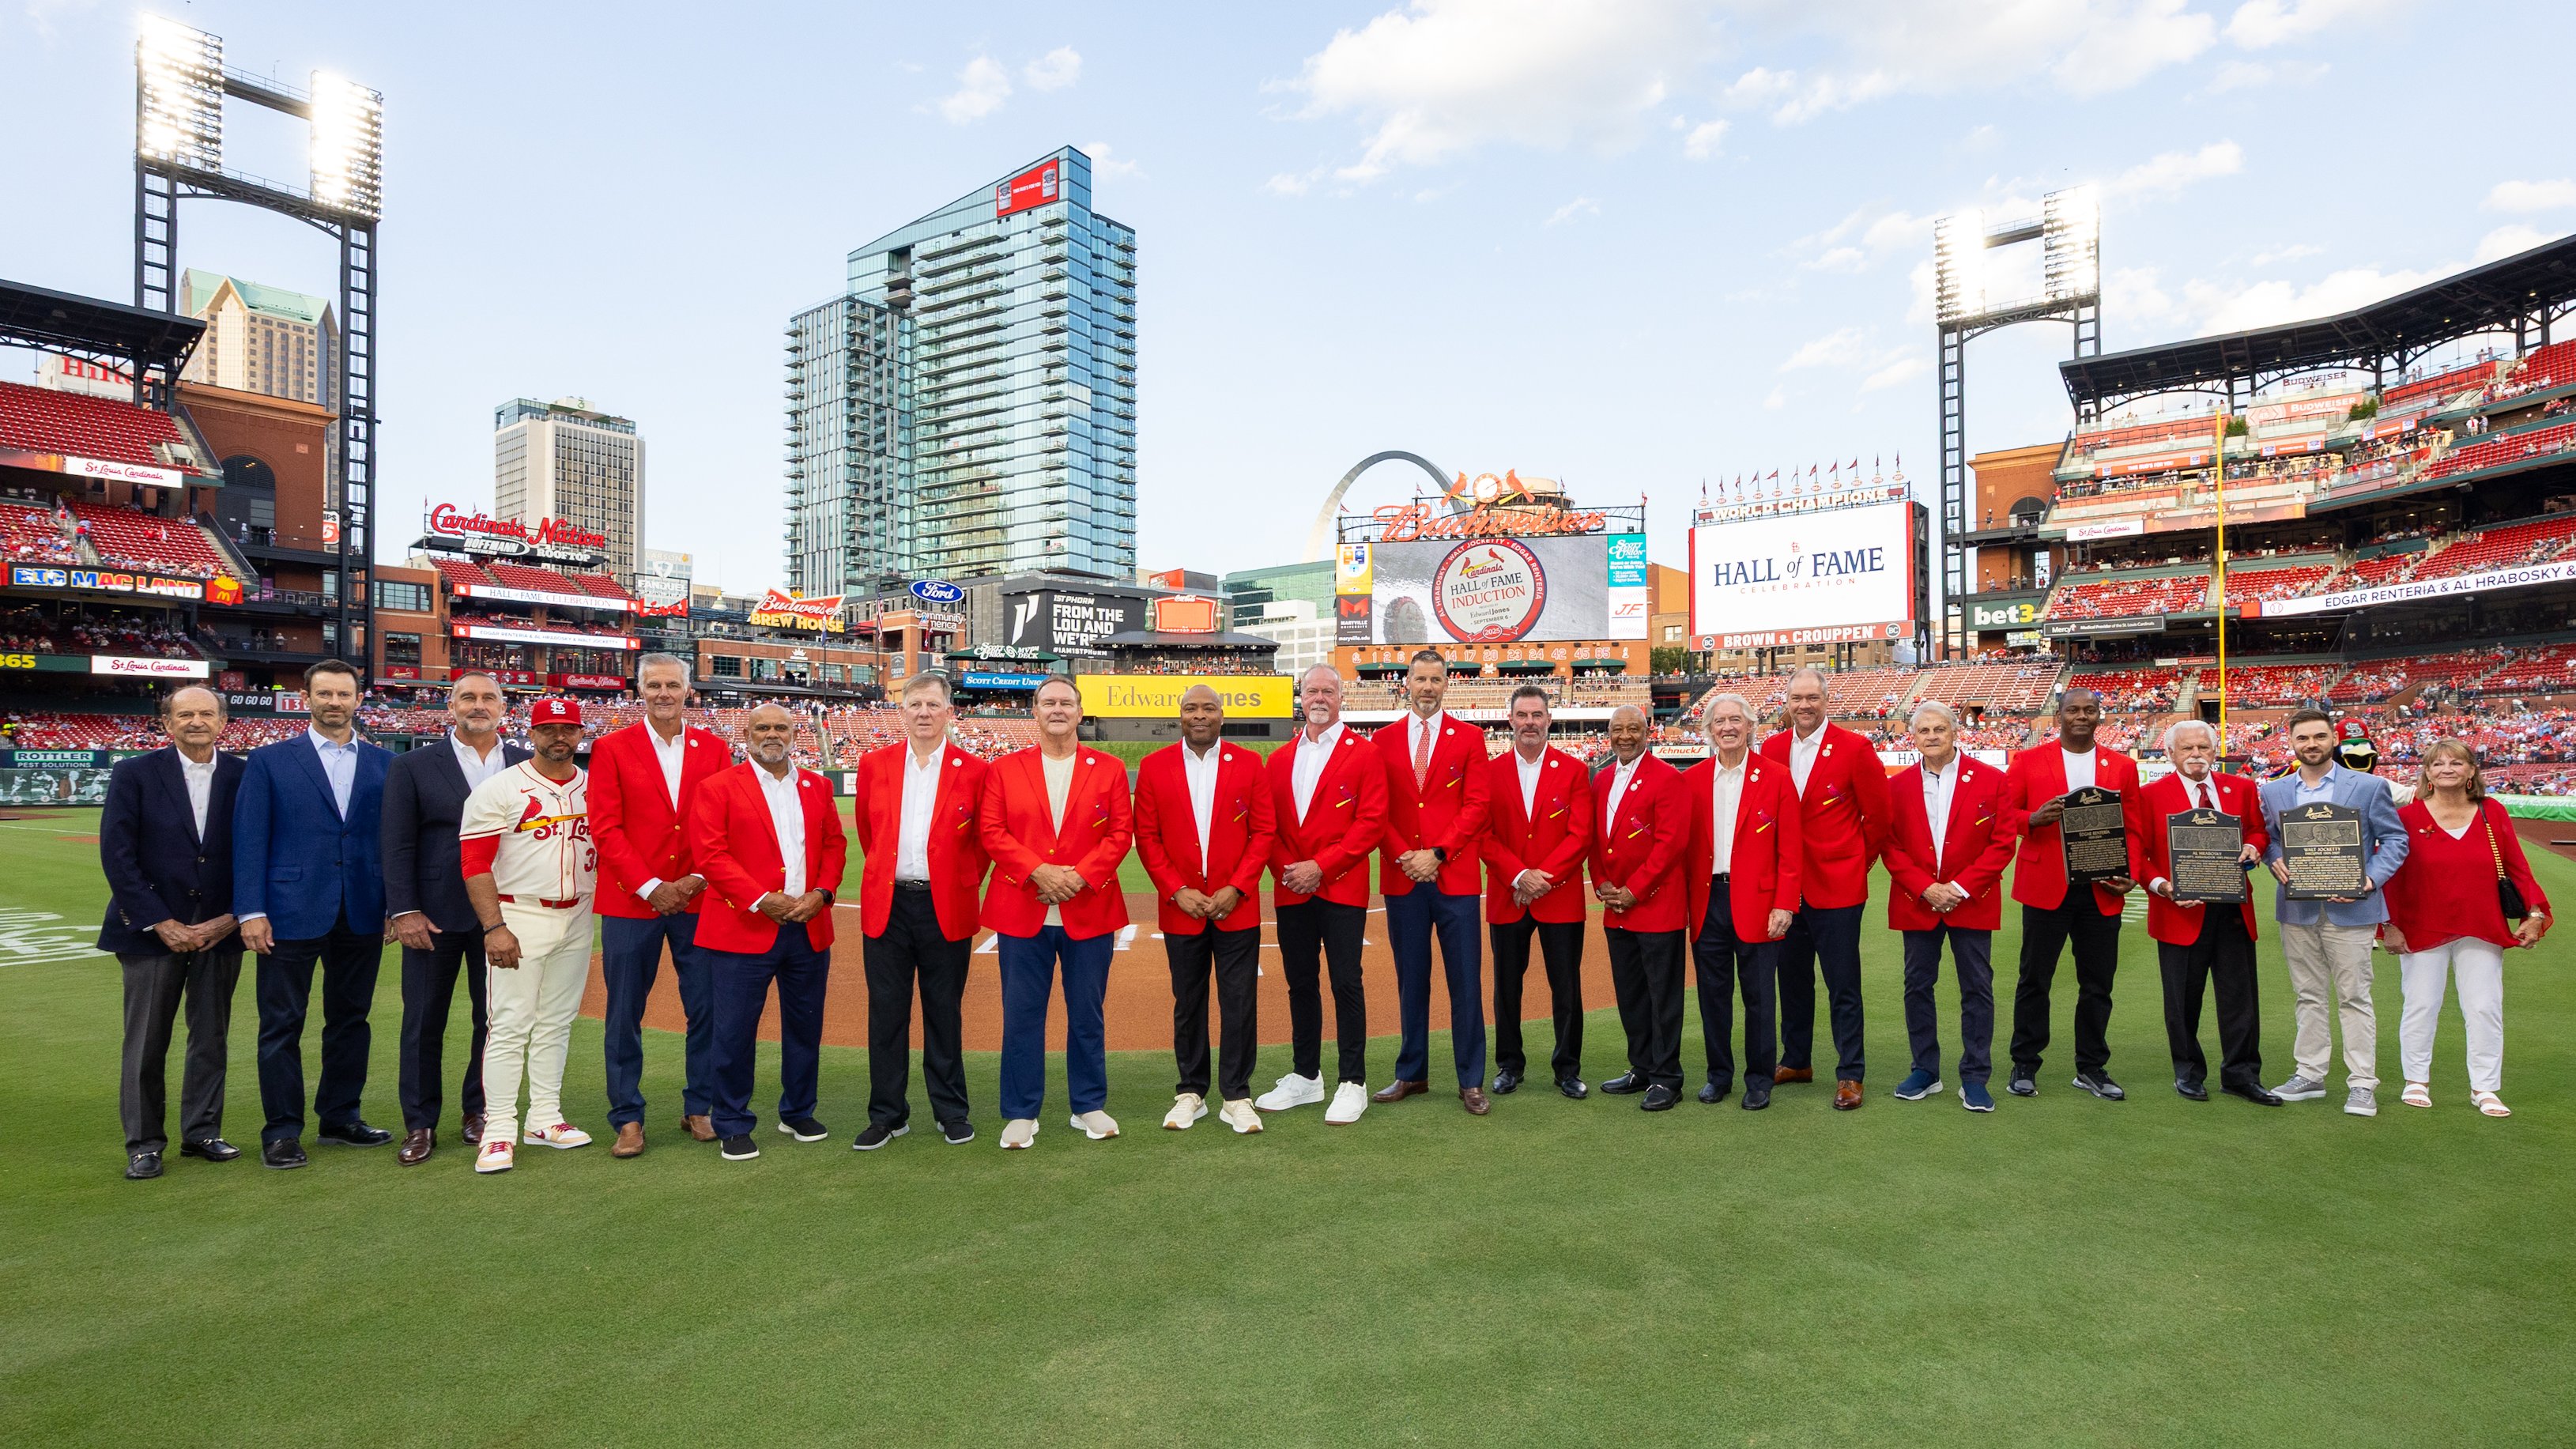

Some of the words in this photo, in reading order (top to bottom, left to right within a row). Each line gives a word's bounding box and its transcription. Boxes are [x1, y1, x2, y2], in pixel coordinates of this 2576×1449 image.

[2283, 372, 2347, 387] BUDWEISER
[2291, 397, 2356, 413] BUDWEISER
[99, 464, 122, 475] Louis
[125, 467, 164, 480] Cardinals
[1712, 504, 1771, 519] WORLD
[1781, 489, 1889, 510] CHAMPIONS
[431, 504, 527, 538] Cardinals
[527, 517, 605, 548] Nation
[1373, 503, 1605, 541] Budweiser
[2103, 526, 2130, 534] Cardinals
[464, 538, 520, 553] HOFFMANN
[1448, 546, 1465, 561] WALT
[1467, 538, 1505, 549] JOCKETTY
[537, 548, 591, 562] ROOFTOP
[1466, 563, 1503, 579] Cardinals
[1714, 557, 1781, 587] HALL
[1786, 555, 1805, 578] of
[1812, 546, 1884, 578] FAME
[13, 568, 66, 587] BIG
[70, 570, 134, 591] MAC
[136, 575, 202, 599] LAND
[1433, 566, 1446, 606] HRABOSKY
[1450, 580, 1481, 595] HALL
[1481, 579, 1490, 589] of
[1491, 572, 1522, 588] FAME
[1740, 578, 1855, 594] CELEBRATION
[2440, 583, 2449, 592] &
[2453, 579, 2471, 591] AL
[2476, 567, 2562, 588] HRABOSKY
[489, 589, 513, 598] HALL
[521, 592, 543, 602] FAME
[545, 594, 612, 607] CELEBRATION
[922, 582, 954, 598] Ford
[1451, 585, 1526, 609] INDUCTION
[759, 595, 843, 616] Budweiser
[1053, 604, 1093, 620] FROM
[1096, 608, 1124, 622] THE
[1437, 606, 1446, 617] AL
[1470, 609, 1492, 618] Edward
[1492, 606, 1510, 616] Jones
[751, 613, 794, 628] BREW
[796, 616, 845, 632] HOUSE
[915, 609, 964, 625] Community
[1473, 616, 1503, 625] SEPTEMBER
[1974, 604, 2035, 625] bet3
[1053, 617, 1081, 632] LOU
[1084, 621, 1114, 634] AND
[1724, 632, 1775, 648] BROWN
[1778, 634, 1789, 644] &
[1888, 626, 1899, 635] BC
[2006, 632, 2040, 640] bet365
[1372, 652, 1377, 663] 1
[1384, 651, 1391, 663] 2
[1397, 651, 1405, 662] 6
[1445, 650, 1458, 662] 14
[1464, 650, 1477, 662] 17
[1483, 649, 1499, 662] 20
[1507, 649, 1522, 661] 23
[1529, 648, 1544, 661] 24
[1551, 648, 1567, 660] 42
[1574, 647, 1590, 659] 45
[1594, 647, 1611, 659] 85
[124, 660, 148, 672] Louis
[151, 661, 190, 672] Cardinals
[992, 677, 1020, 685] CREDIT
[1022, 677, 1043, 686] UNIO
[230, 695, 243, 704] GO
[245, 696, 258, 705] GO
[259, 696, 273, 706] GO
[1222, 692, 1262, 707] nes
[1450, 711, 1469, 719] AME
[1473, 710, 1508, 719] CELEB
[534, 815, 563, 840] St.
[584, 848, 598, 872] 3
